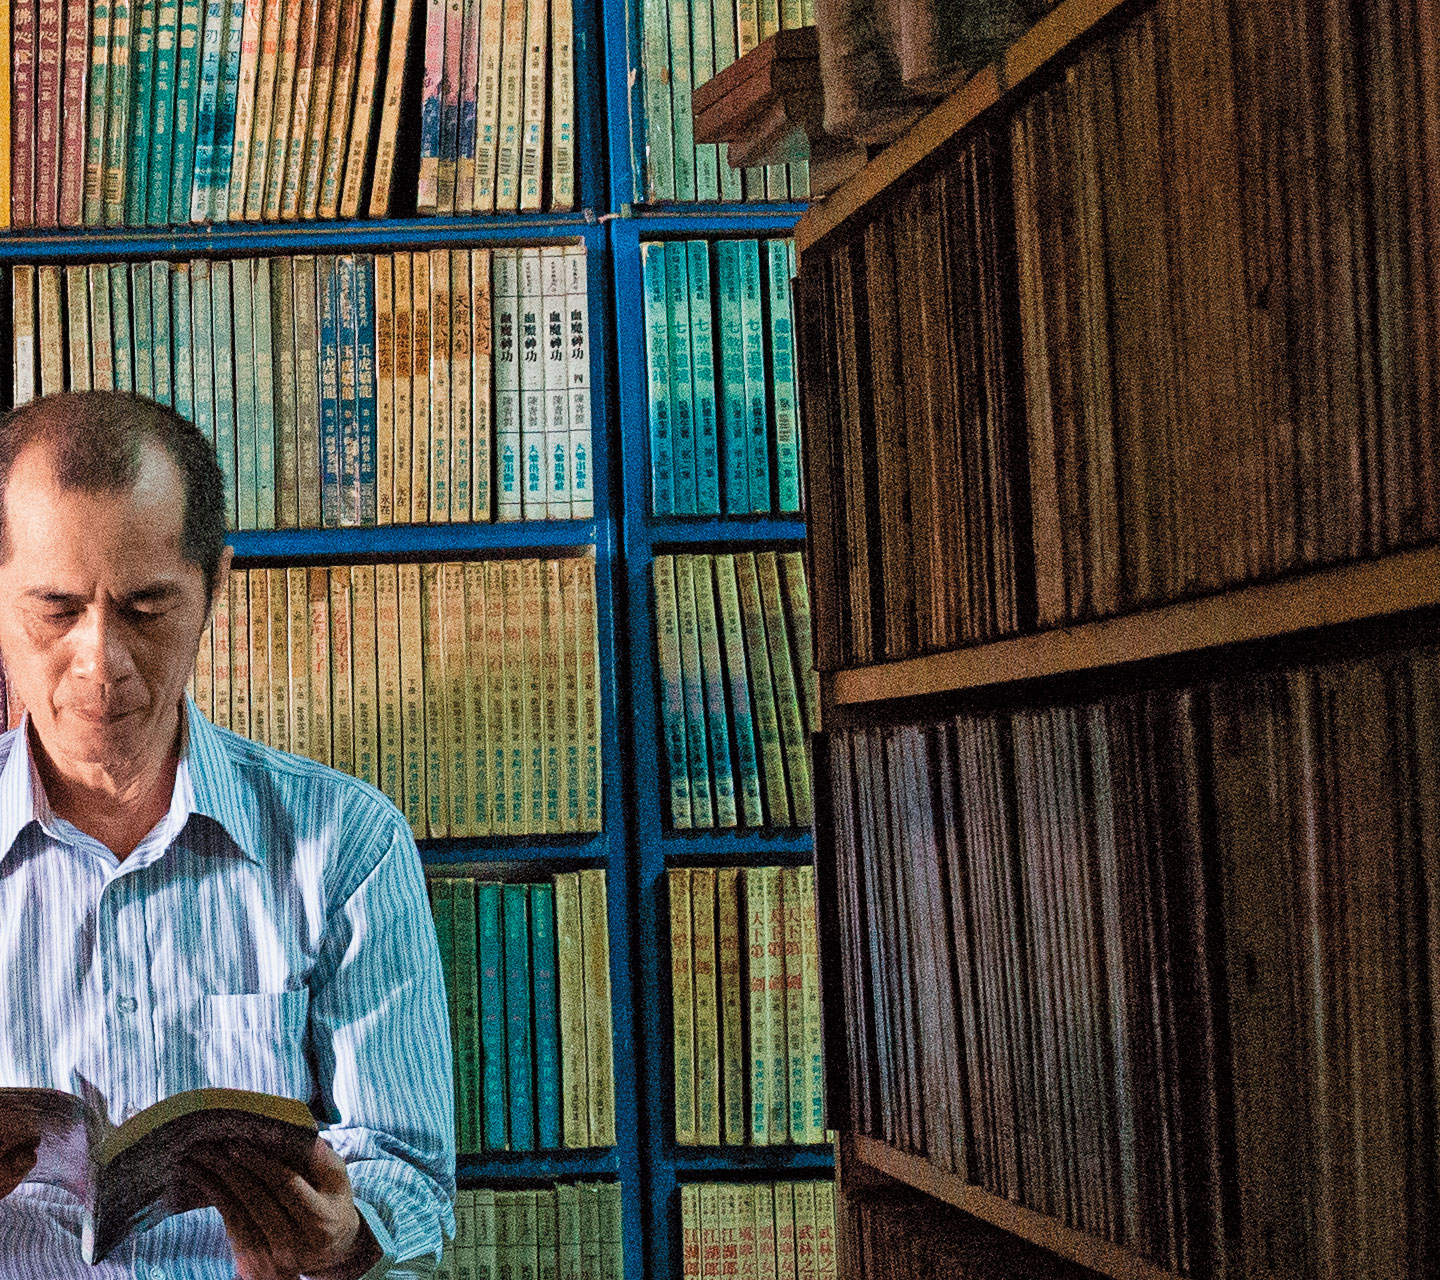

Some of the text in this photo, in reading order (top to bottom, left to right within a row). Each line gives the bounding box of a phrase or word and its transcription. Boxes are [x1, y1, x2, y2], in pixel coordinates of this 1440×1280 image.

[499, 310, 515, 363] 血魔神功
[524, 309, 538, 363] 血魔神功
[549, 309, 563, 362] 血魔神功
[570, 307, 585, 361] 血魔神功
